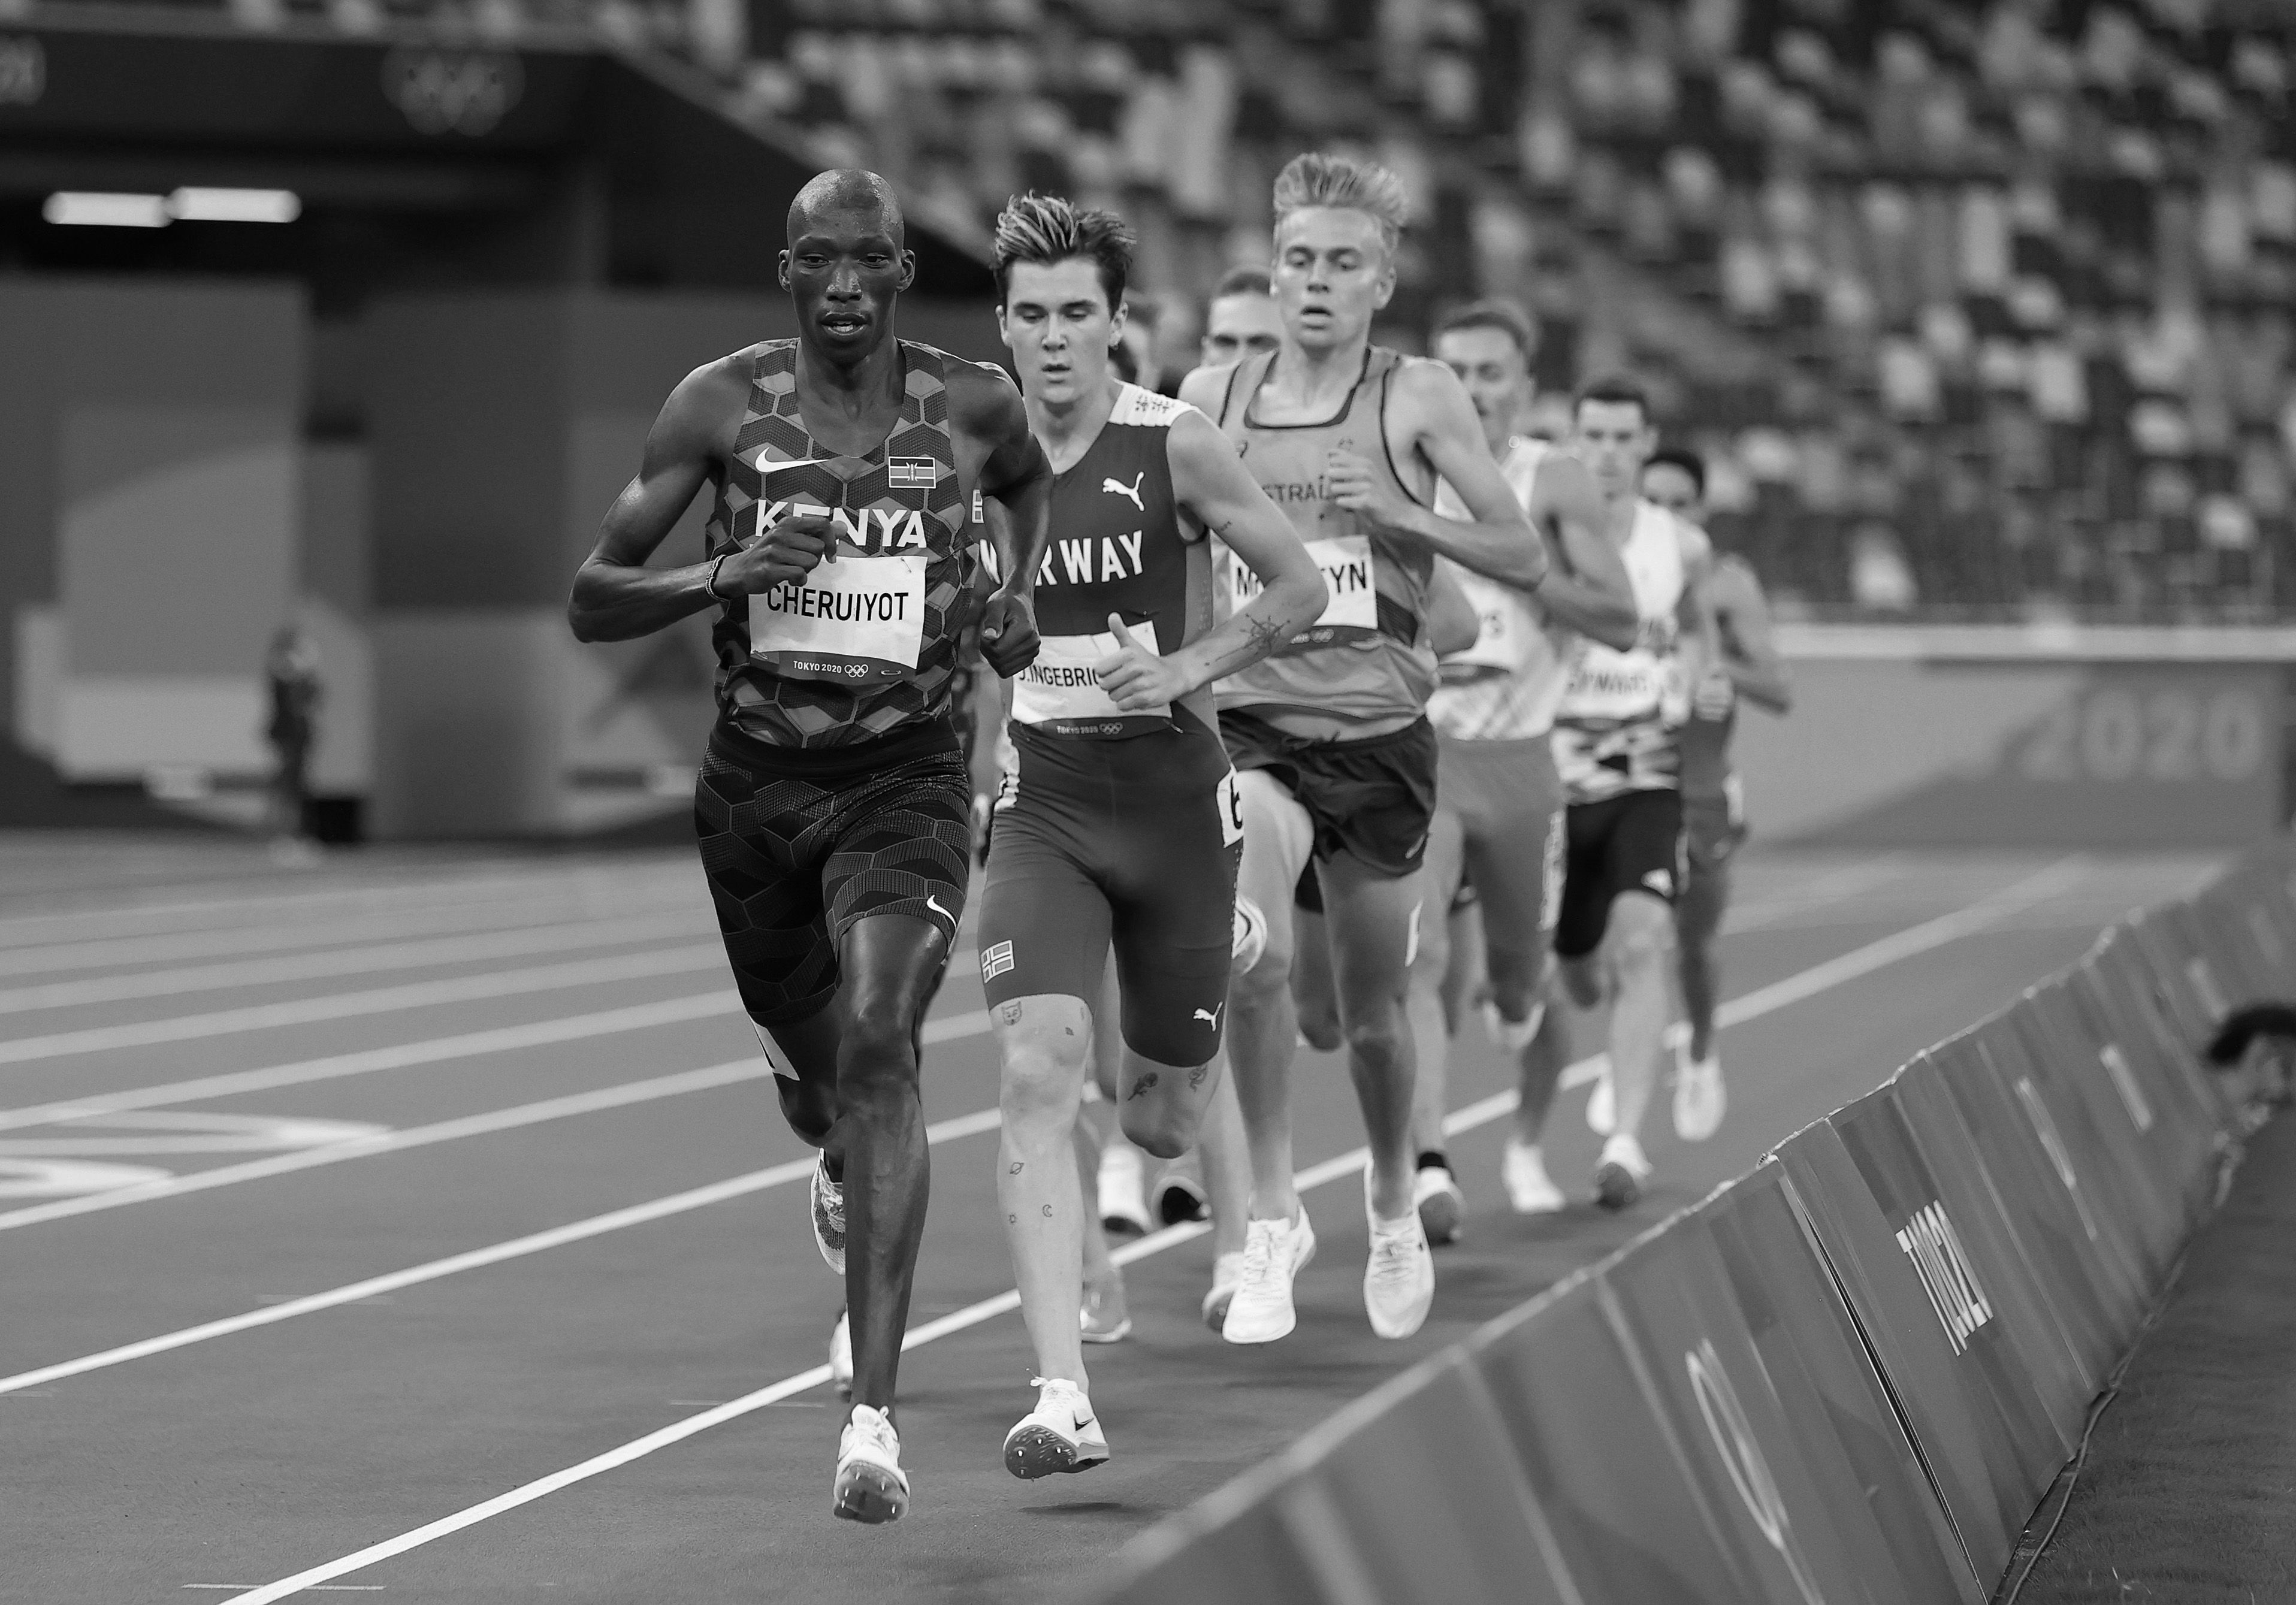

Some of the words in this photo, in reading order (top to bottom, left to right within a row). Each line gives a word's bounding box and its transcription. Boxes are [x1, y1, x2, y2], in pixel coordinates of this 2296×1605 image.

[979, 530, 1143, 586] NRWAY
[767, 583, 909, 622] CHERUIYOT
[793, 660, 820, 671] TOKYO
[821, 664, 842, 674] 2020
[2023, 689, 2264, 780] 2020
